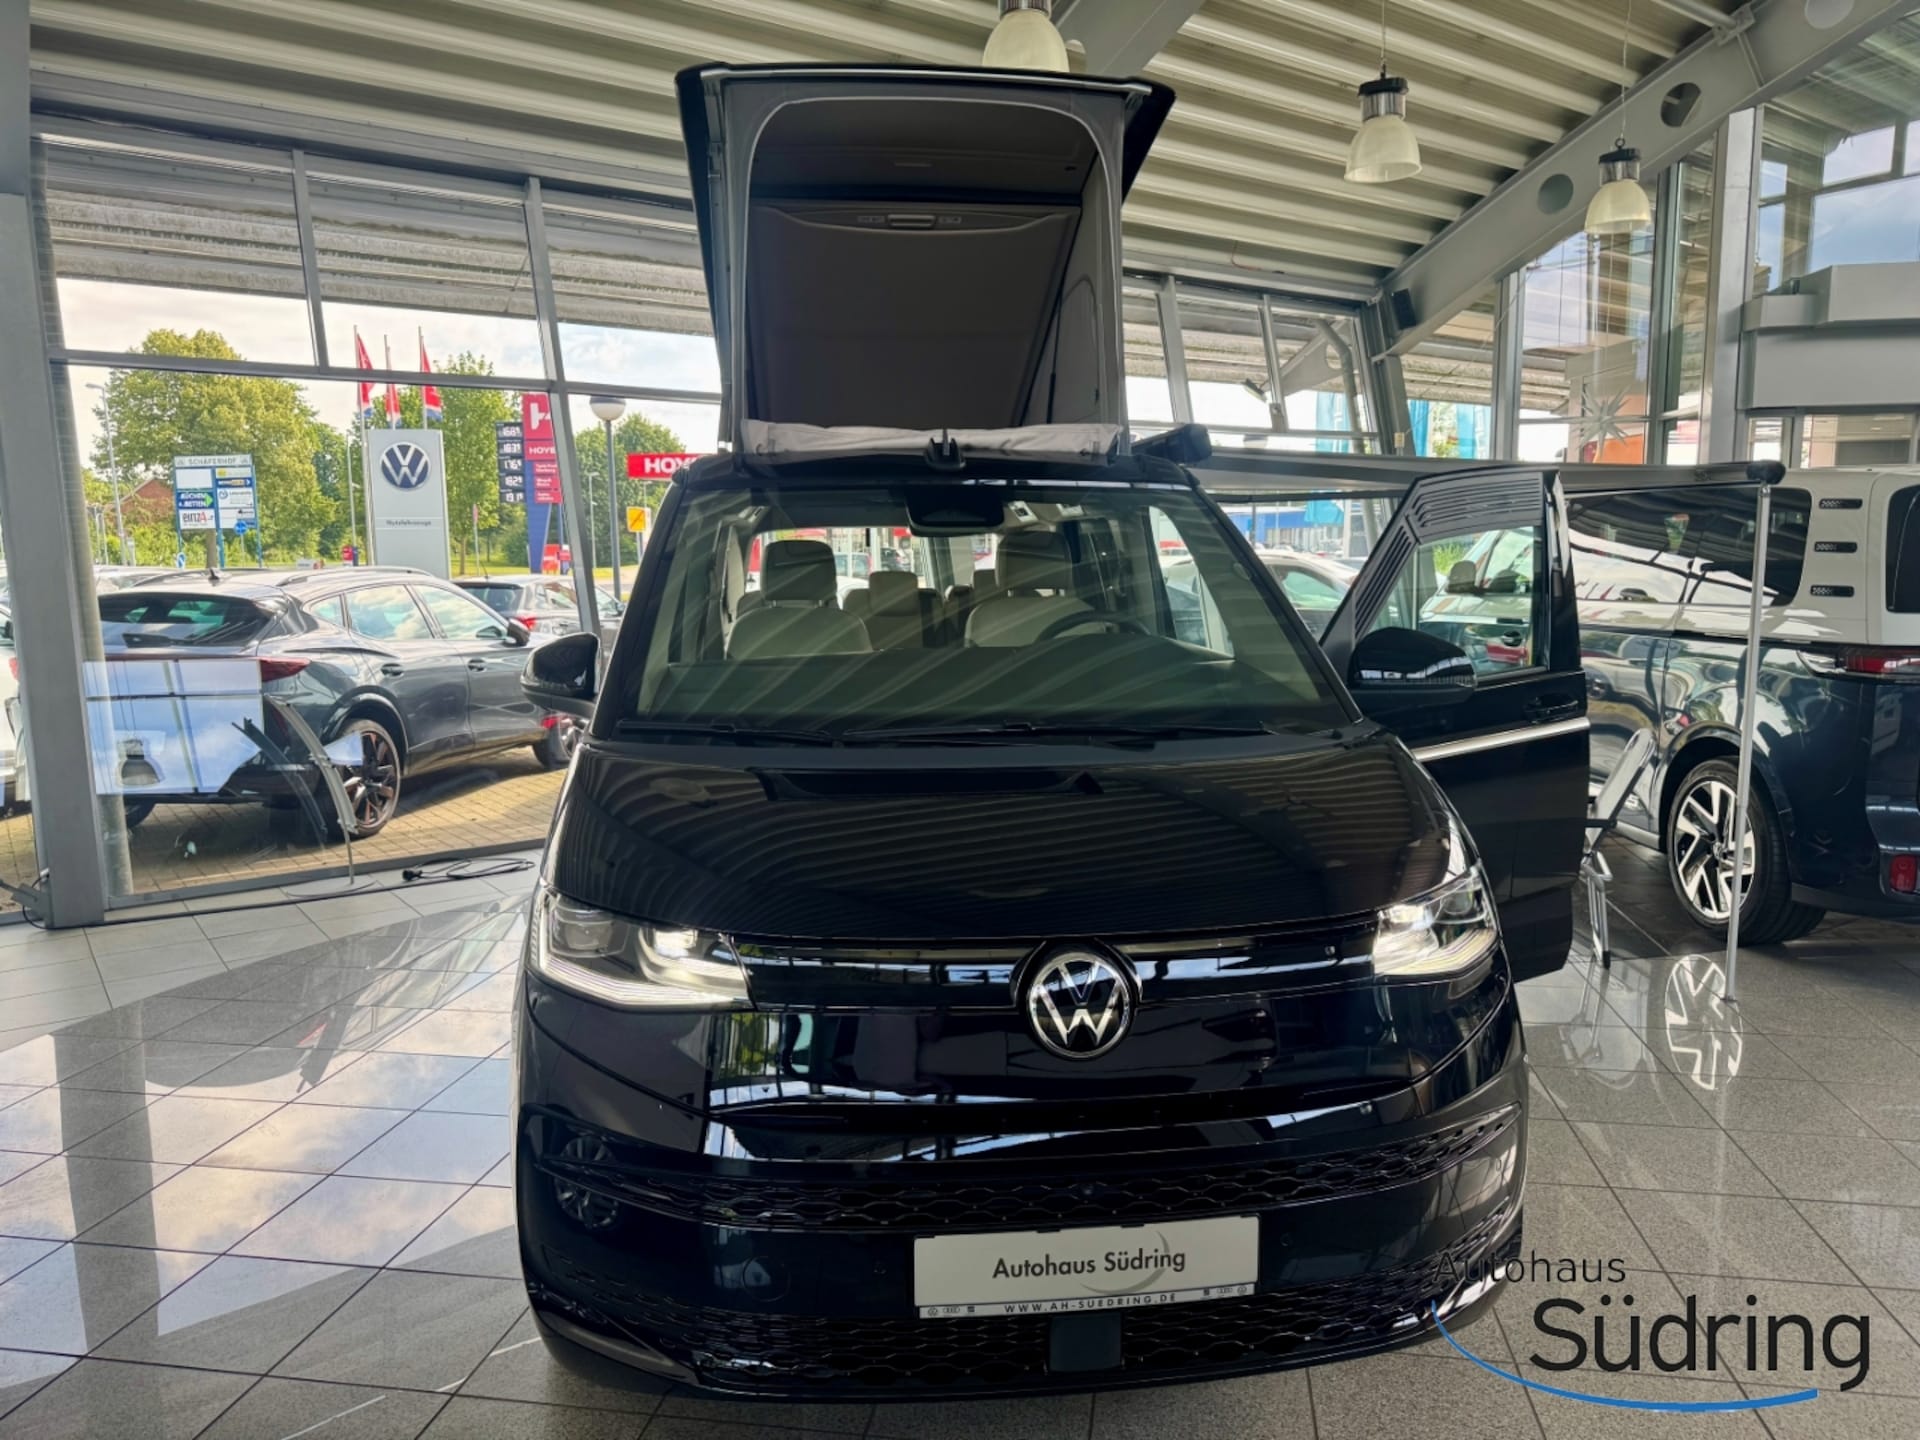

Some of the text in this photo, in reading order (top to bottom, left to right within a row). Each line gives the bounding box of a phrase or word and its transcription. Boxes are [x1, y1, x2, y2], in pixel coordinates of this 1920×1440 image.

[529, 446, 556, 455] HOYE
[992, 1248, 1186, 1279] Autohaus Südring
[1004, 1293, 1177, 1314] WWW.AH-SUEDRING.DE
